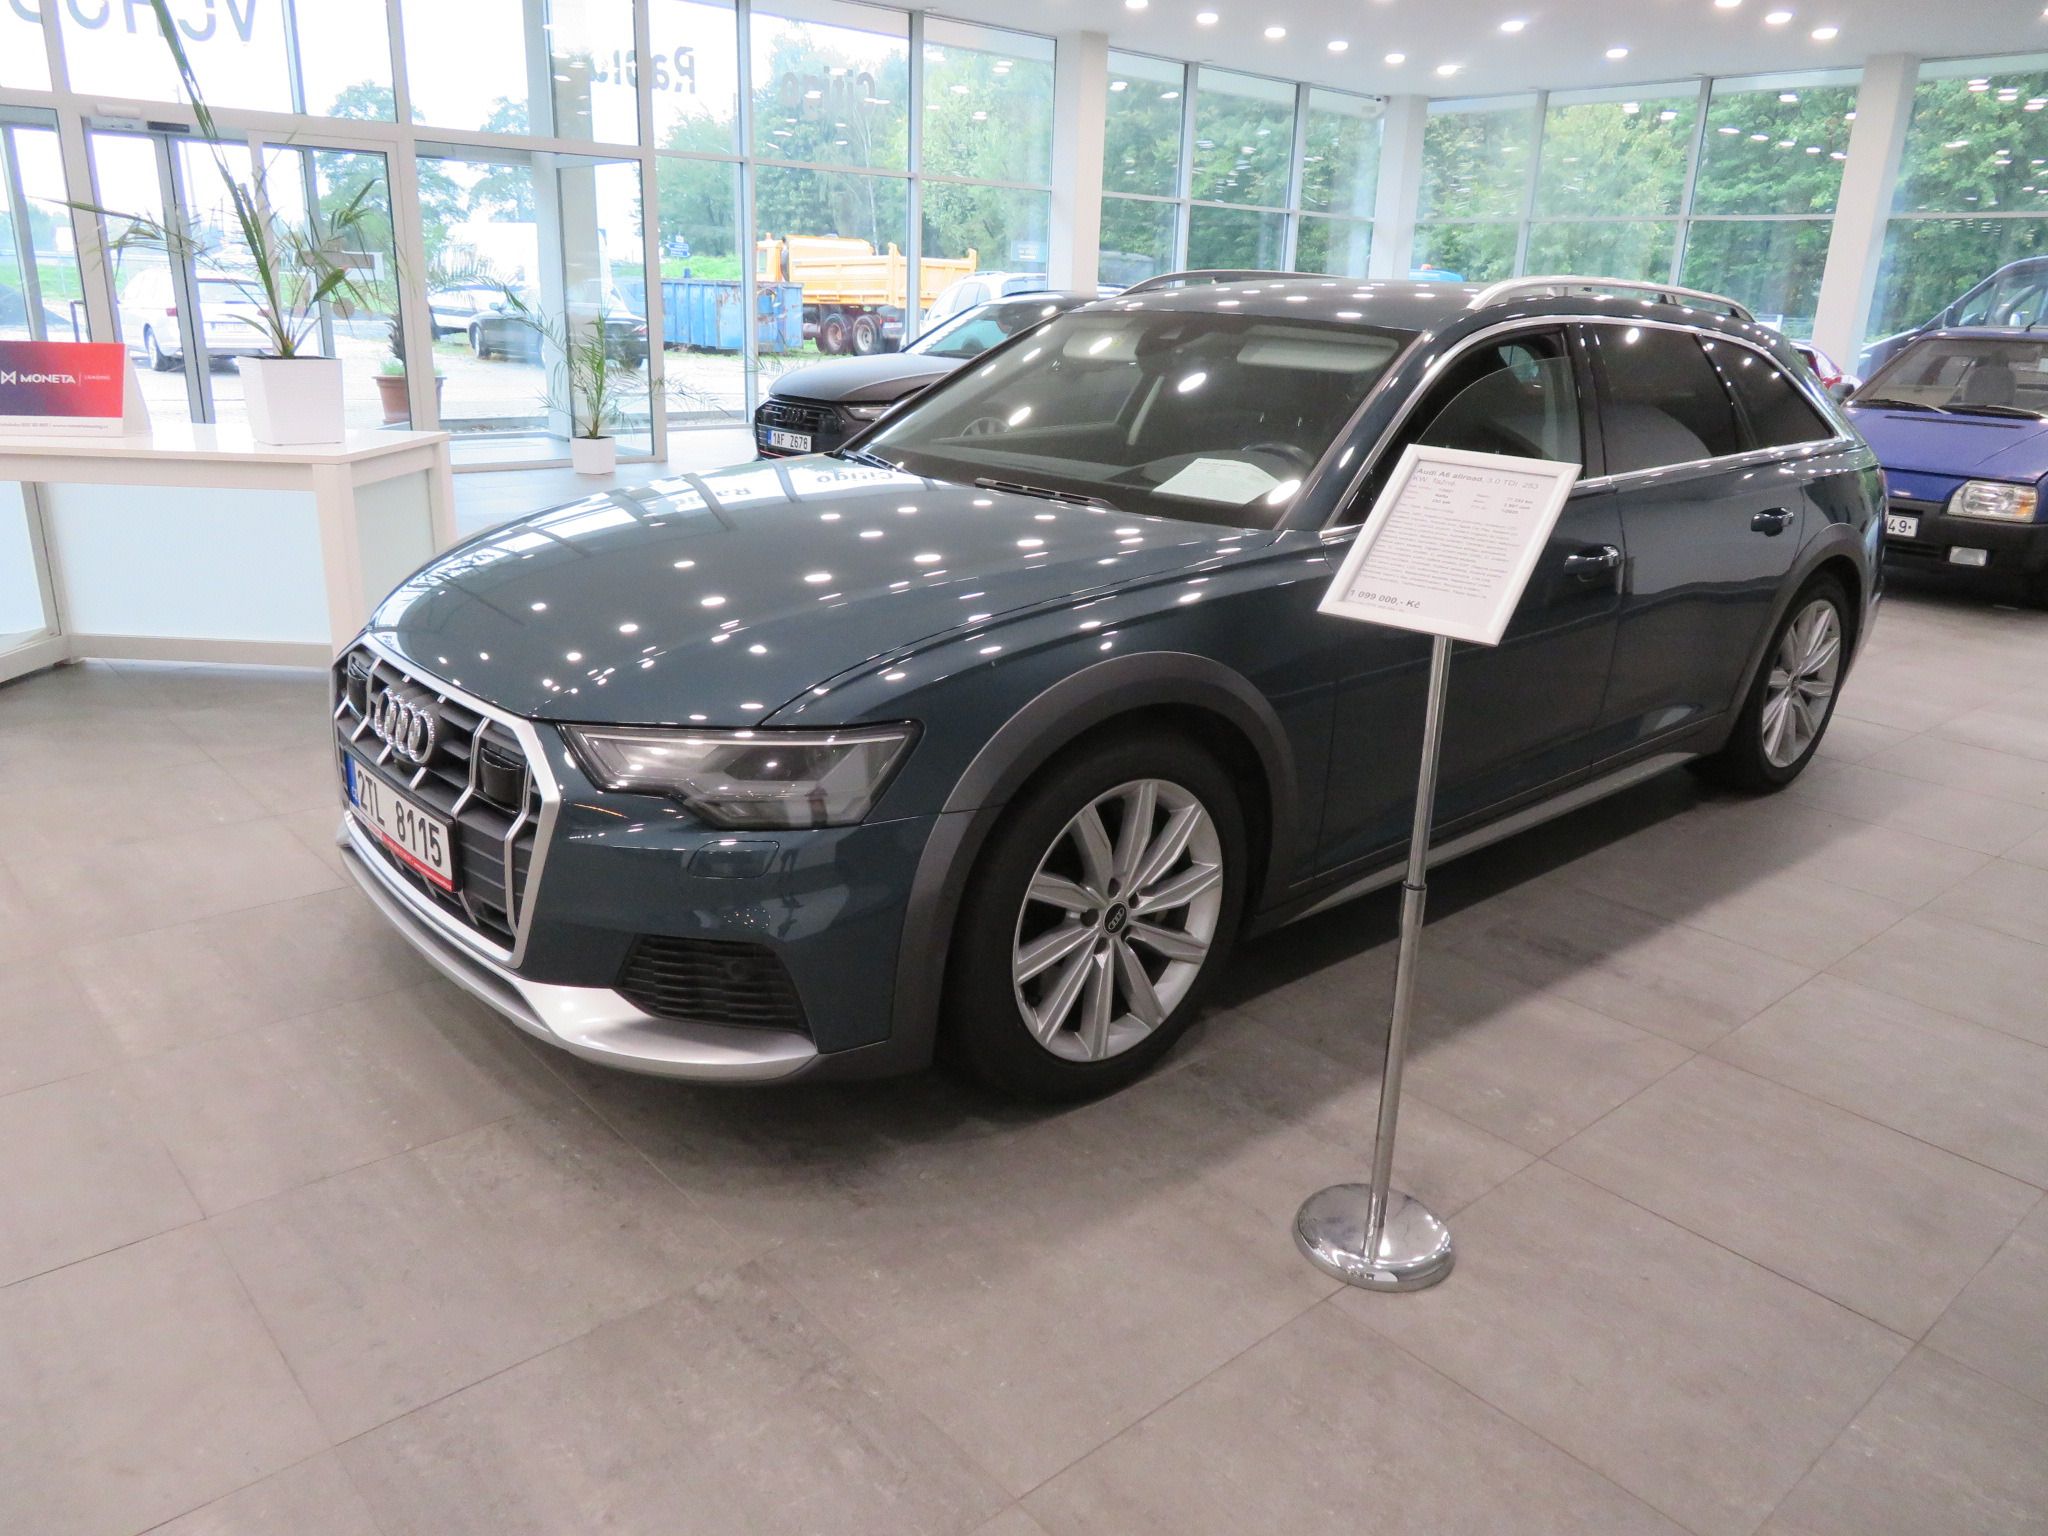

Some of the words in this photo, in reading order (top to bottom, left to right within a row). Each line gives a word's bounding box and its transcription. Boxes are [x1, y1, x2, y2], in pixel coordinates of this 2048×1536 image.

[20, 373, 77, 385] MONETA
[773, 432, 785, 446] 1AF
[1417, 467, 1437, 477] Audi
[1438, 470, 1451, 479] A6
[1888, 518, 1908, 534] 49
[1358, 591, 1377, 601] 099
[1405, 599, 1422, 609] Kč
[357, 769, 386, 827] 2TL
[395, 800, 442, 868] 8115
